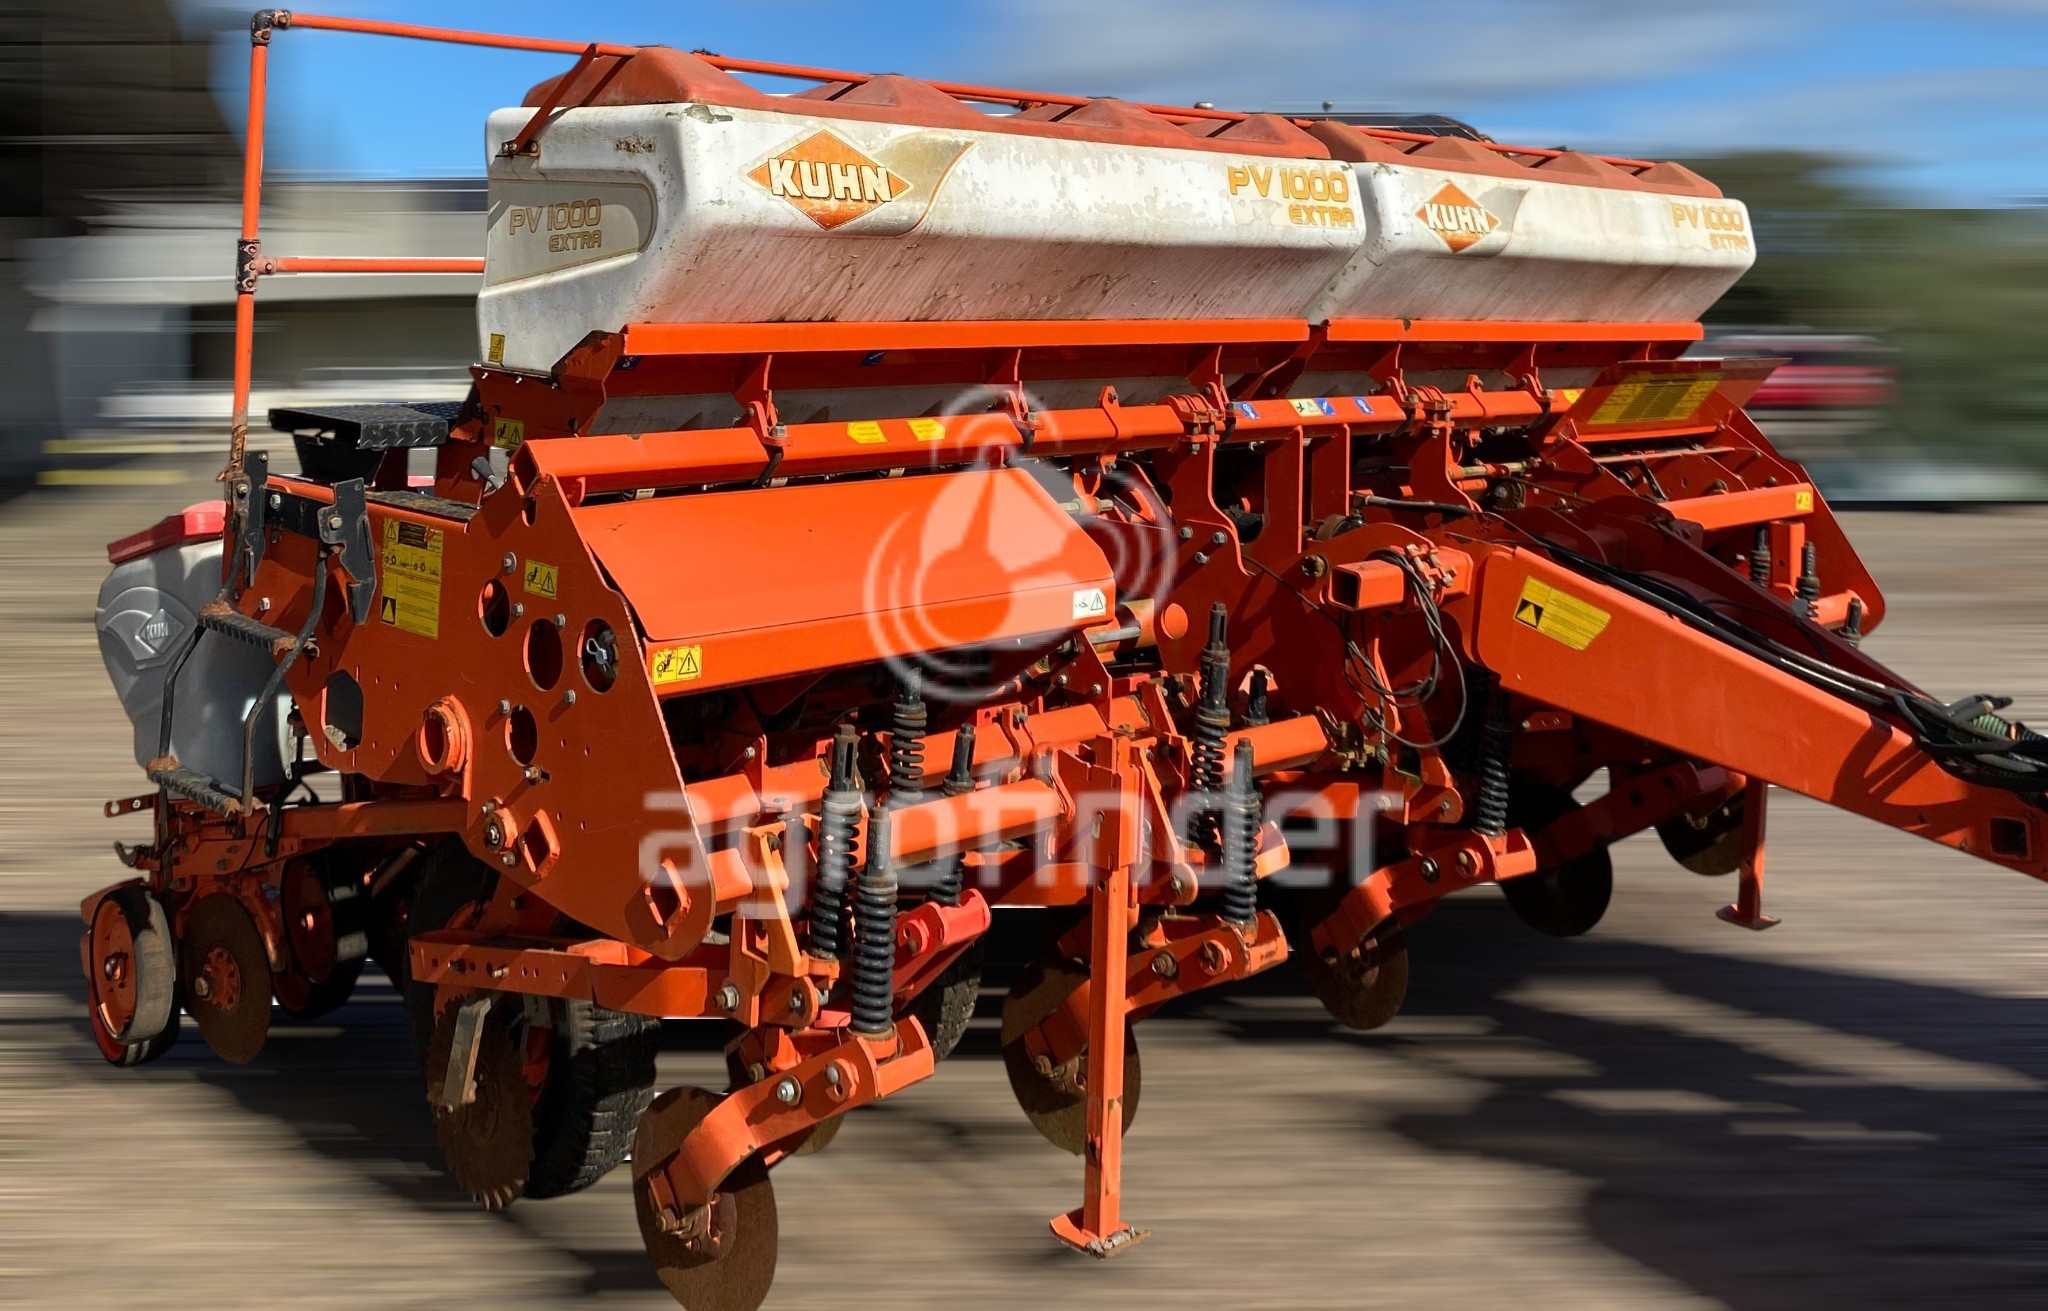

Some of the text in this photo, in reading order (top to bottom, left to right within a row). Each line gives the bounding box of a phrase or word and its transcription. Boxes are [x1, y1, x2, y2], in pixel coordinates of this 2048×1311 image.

[768, 157, 893, 202] KUHN
[1228, 165, 1350, 202] PV 1000
[509, 198, 602, 236] PV 1000
[1288, 204, 1355, 227] EXTRA
[1424, 202, 1491, 234] KUHN
[1671, 203, 1744, 231] PV 1000
[549, 229, 602, 252] EXTRA
